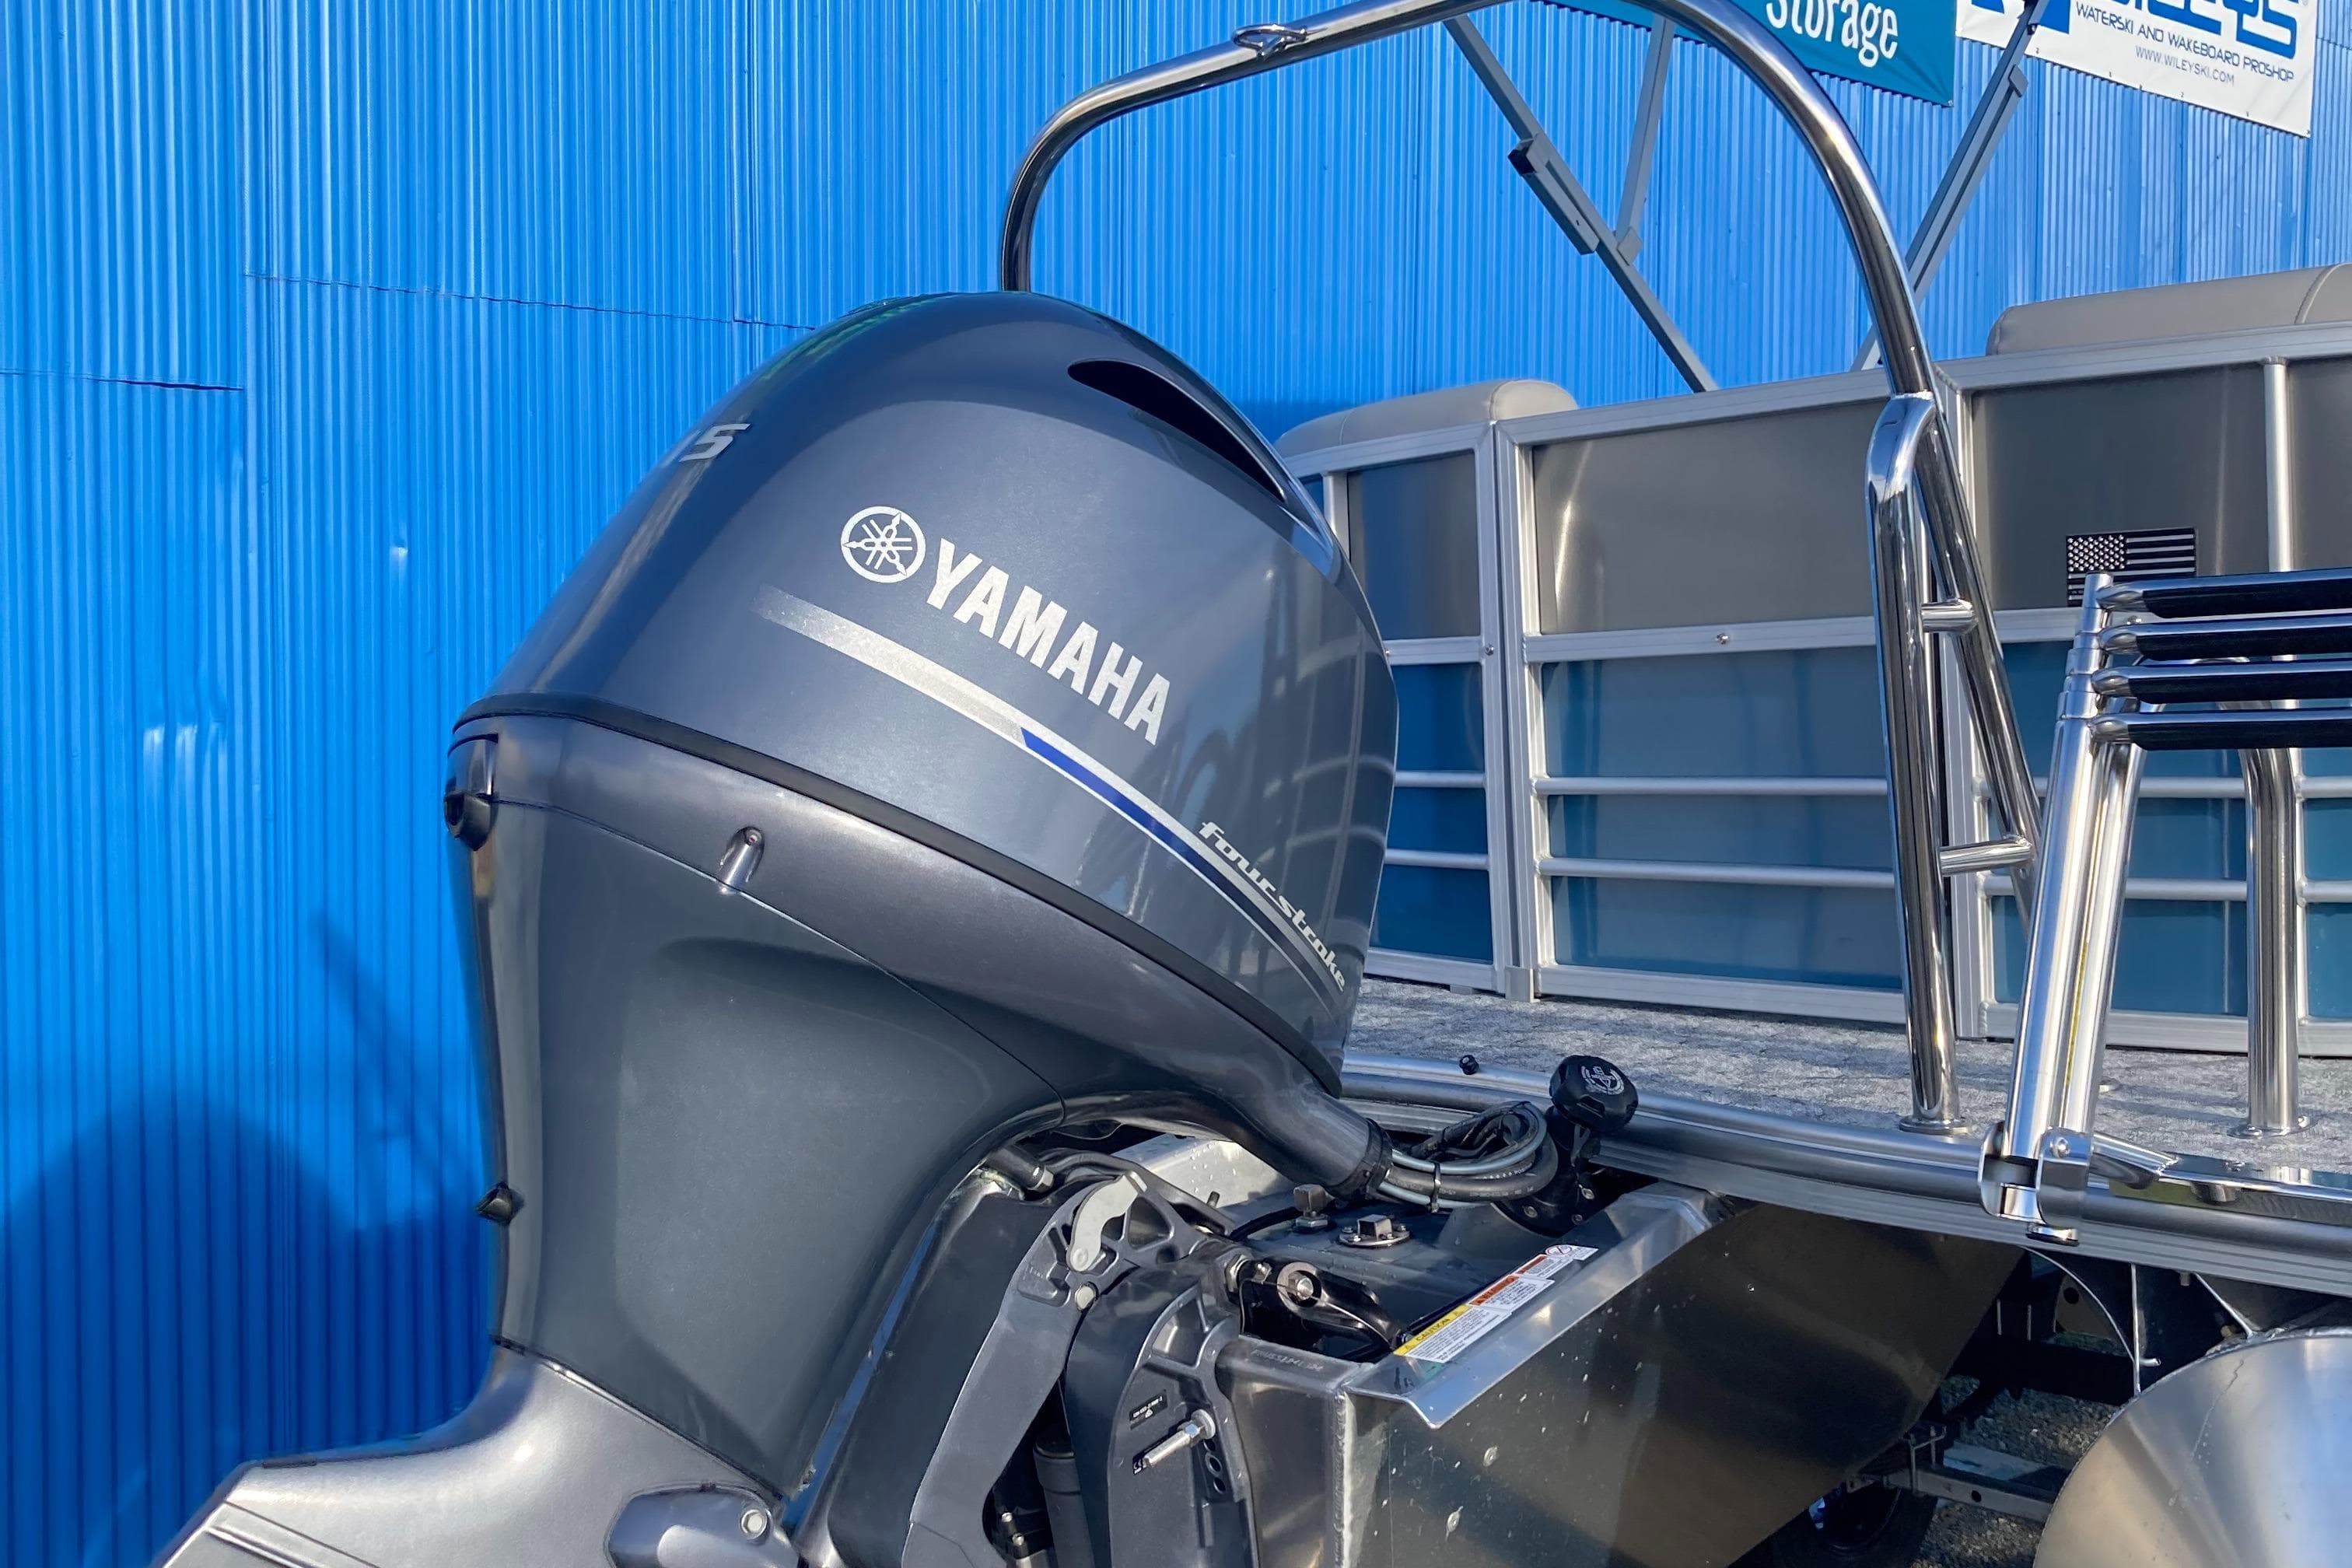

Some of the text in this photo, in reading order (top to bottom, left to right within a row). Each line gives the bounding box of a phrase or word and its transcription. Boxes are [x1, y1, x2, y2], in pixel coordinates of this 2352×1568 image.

[2076, 1, 2295, 82] WATERSKI AND WAKEBOARD PROSHOP
[2135, 45, 2235, 86] WWW.WILEYSKI.COM
[926, 537, 1171, 747] YAMAHA
